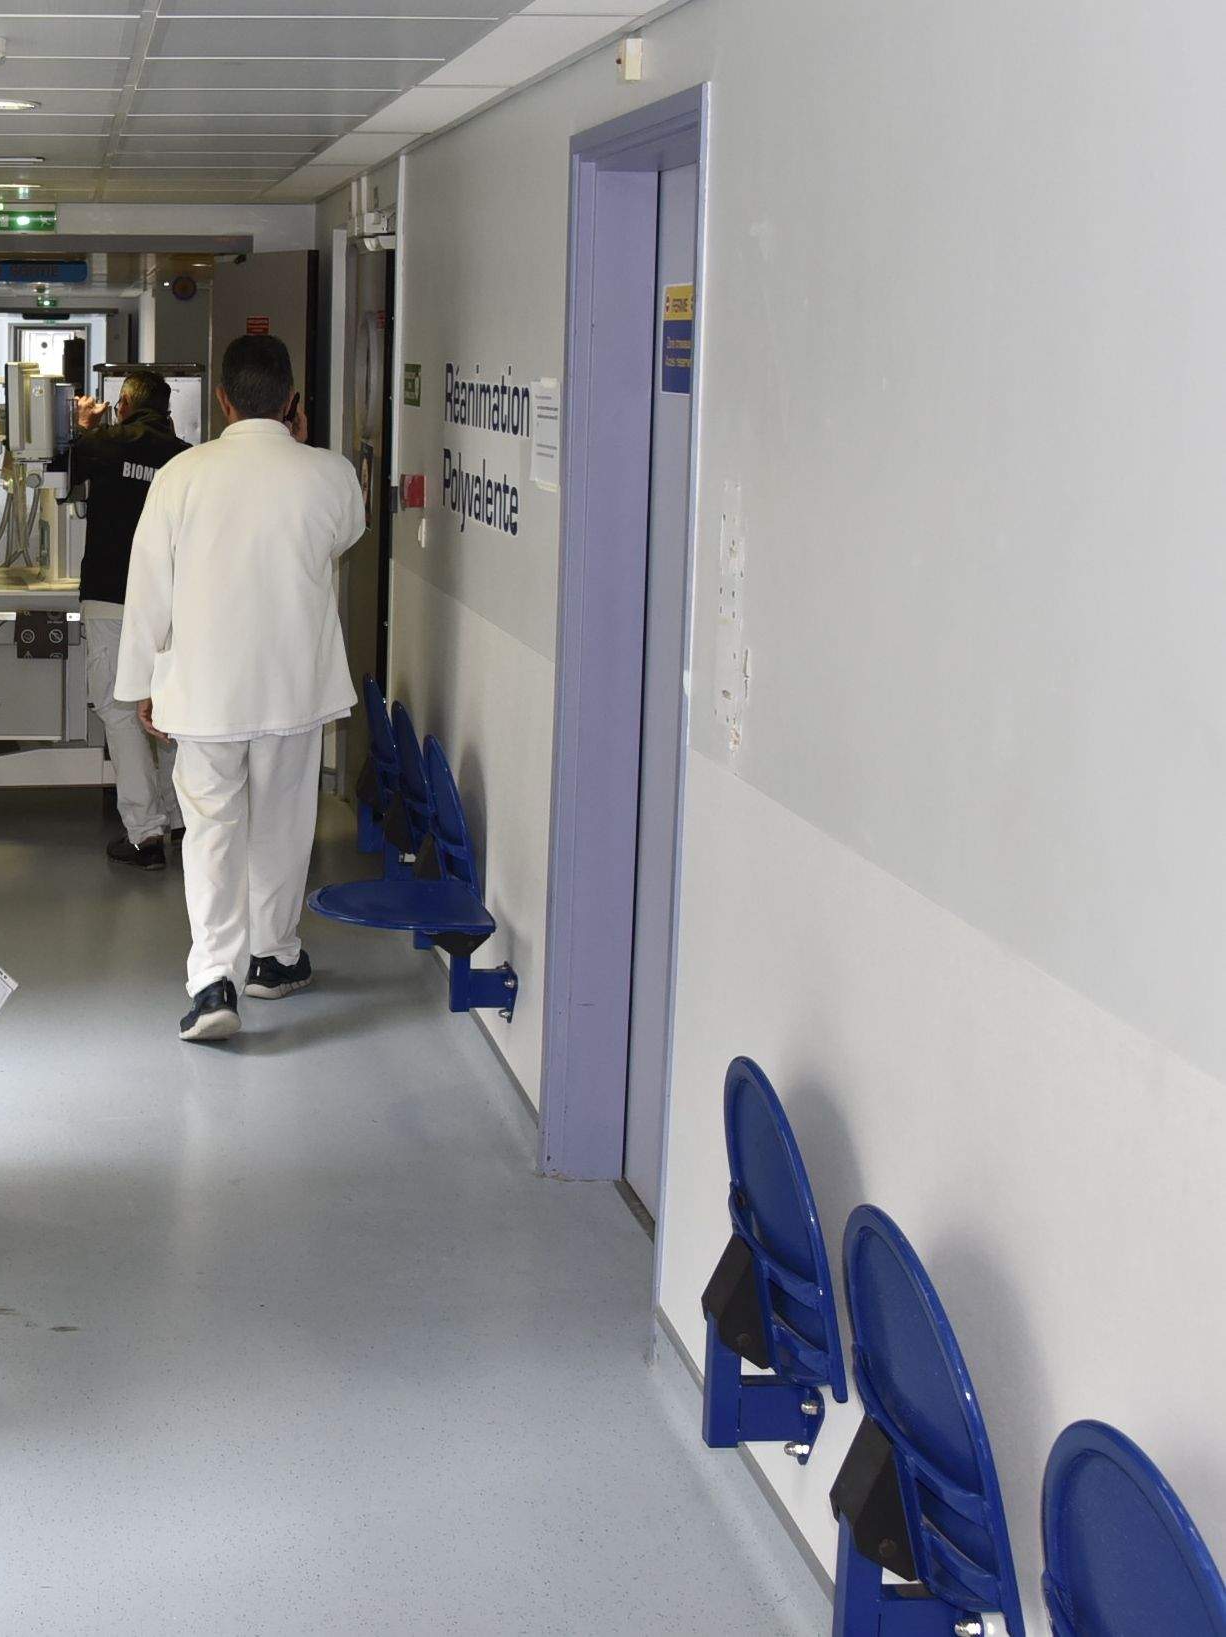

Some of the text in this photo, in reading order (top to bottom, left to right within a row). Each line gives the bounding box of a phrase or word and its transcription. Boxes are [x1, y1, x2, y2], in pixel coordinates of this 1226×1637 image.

[444, 362, 530, 438] Réanimation
[122, 460, 158, 482] BIOM
[442, 447, 519, 536] Polyvalente
